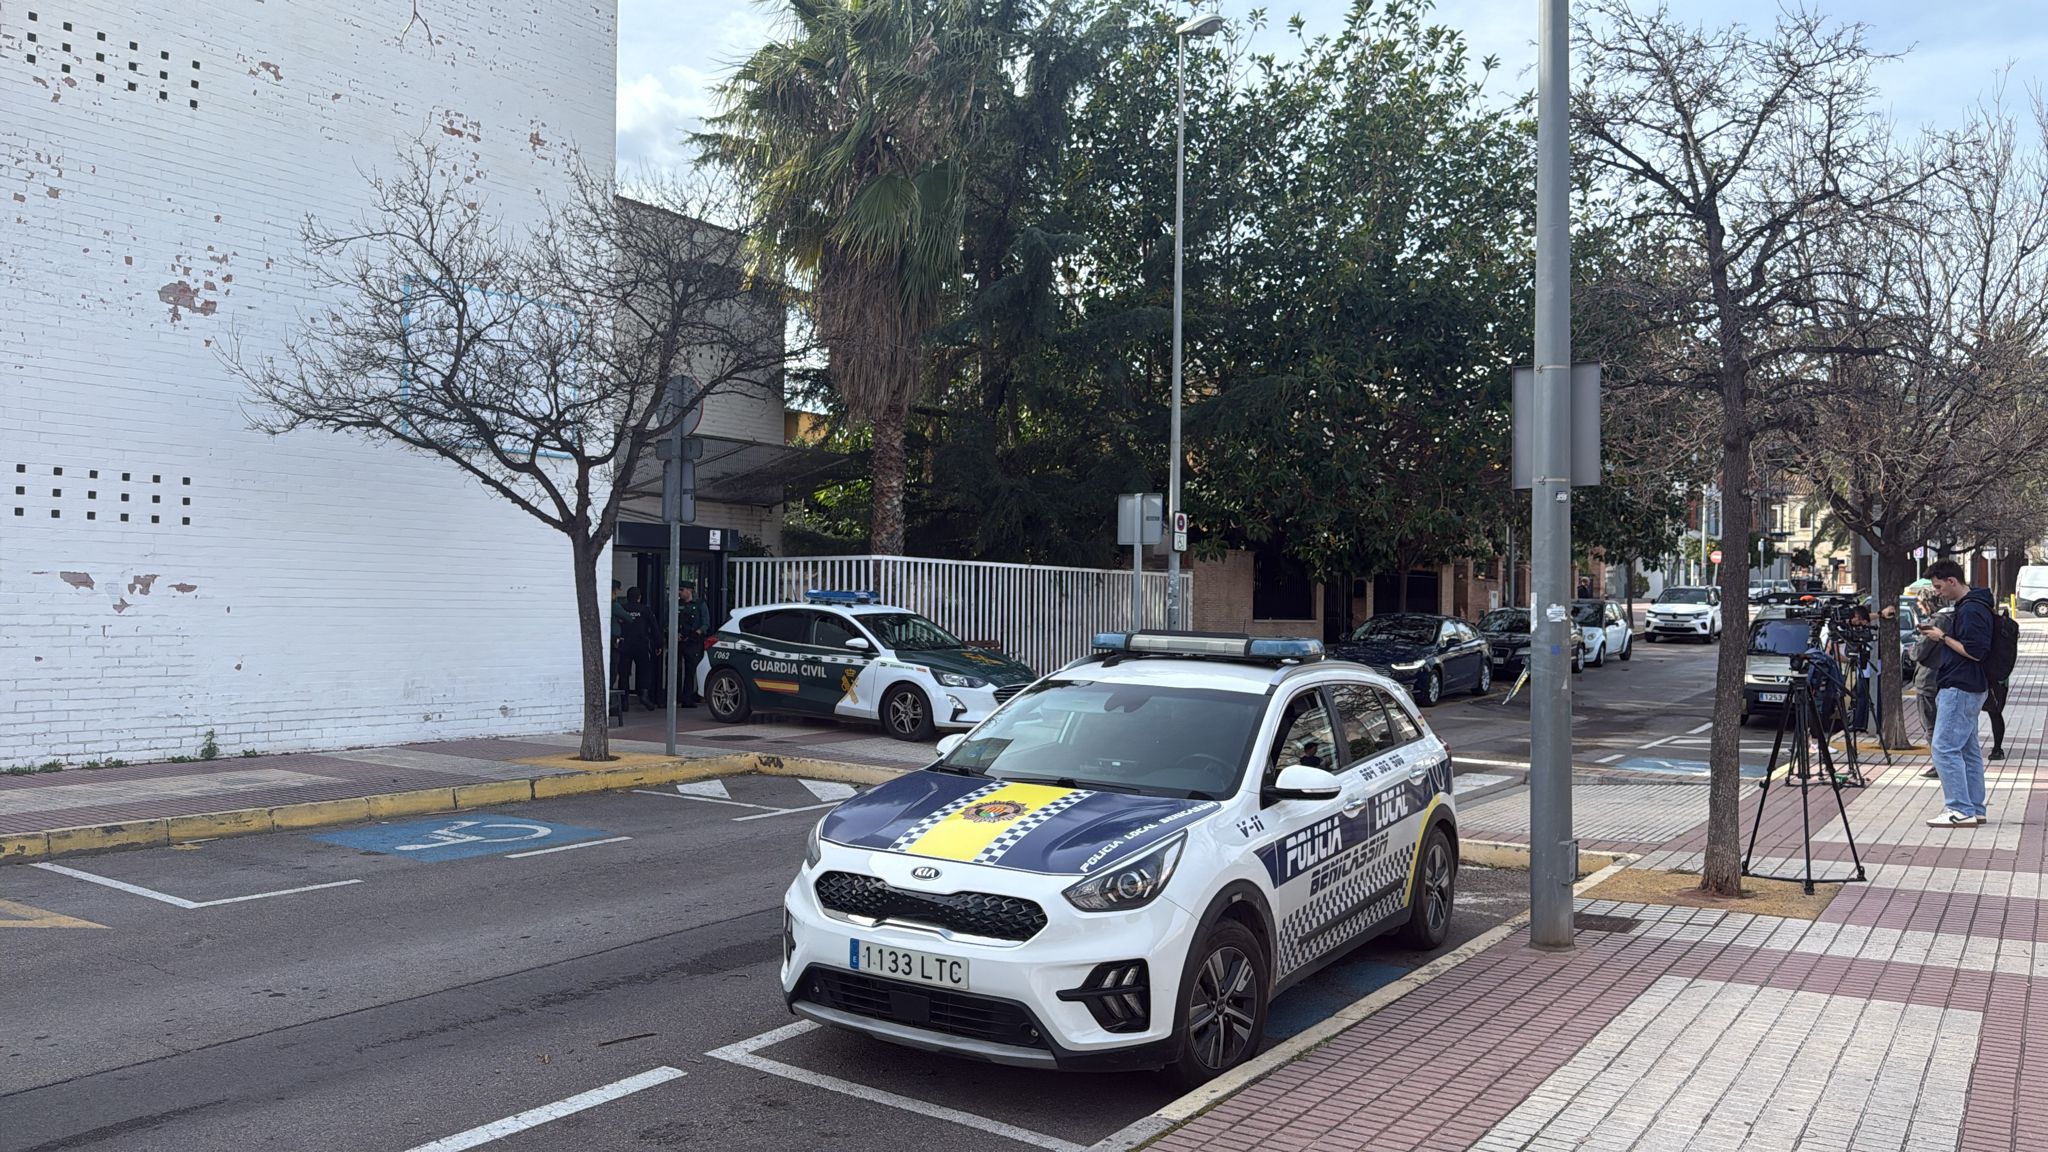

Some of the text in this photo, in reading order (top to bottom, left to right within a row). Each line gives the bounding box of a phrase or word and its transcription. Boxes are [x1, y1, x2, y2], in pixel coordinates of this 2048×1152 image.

[717, 651, 730, 660] 062
[750, 659, 827, 678] GUARDIA CIVIL
[1285, 784, 1408, 878] POLICIA LOCAL
[1079, 839, 1125, 873] POLICIA
[1124, 823, 1159, 840] LOCAL
[914, 867, 936, 878] KIA
[865, 946, 912, 976] 1133
[921, 955, 962, 984] LTC
